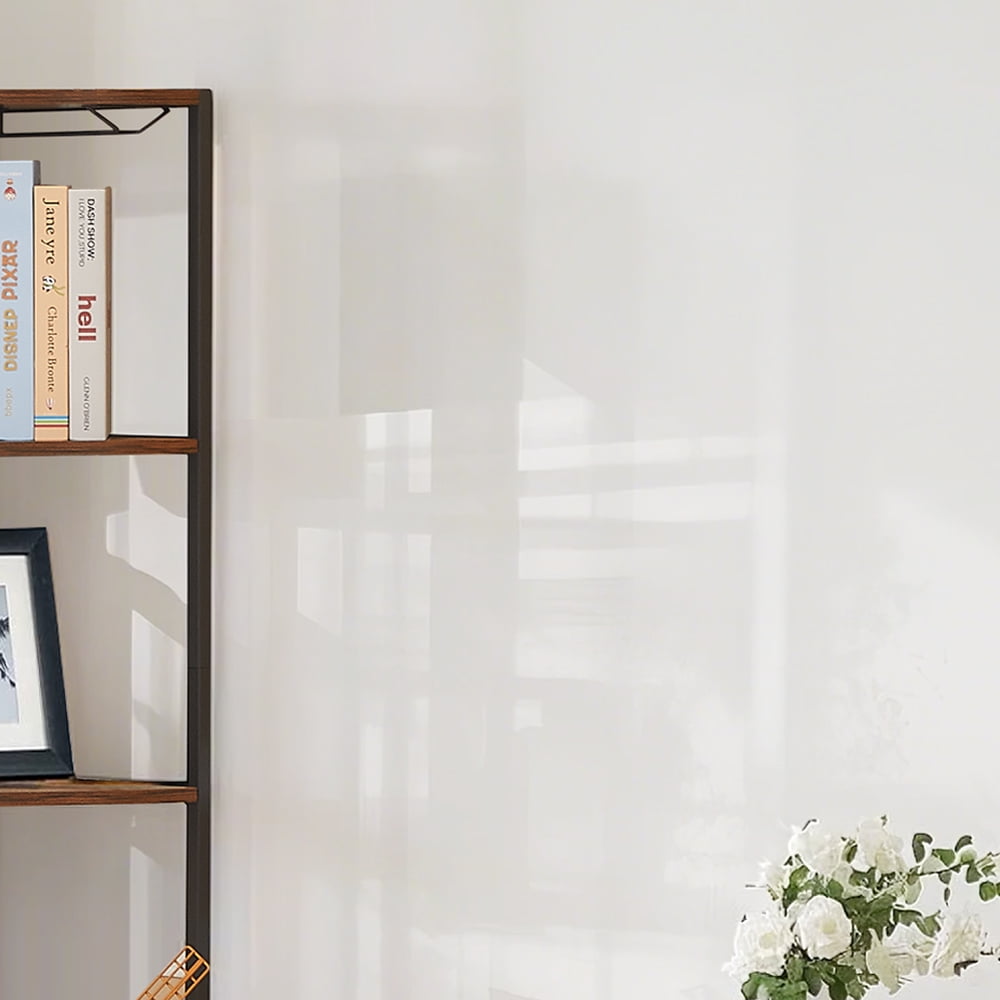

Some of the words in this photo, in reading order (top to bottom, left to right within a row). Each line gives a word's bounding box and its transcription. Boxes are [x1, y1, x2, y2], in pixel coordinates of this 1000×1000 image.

[42, 198, 60, 235] Jane
[87, 198, 96, 226] DASH
[1, 240, 18, 300] PIXAR
[41, 239, 55, 265] yre
[47, 306, 57, 356] Charlotte
[77, 295, 97, 342] hell
[47, 358, 57, 393] Bronte
